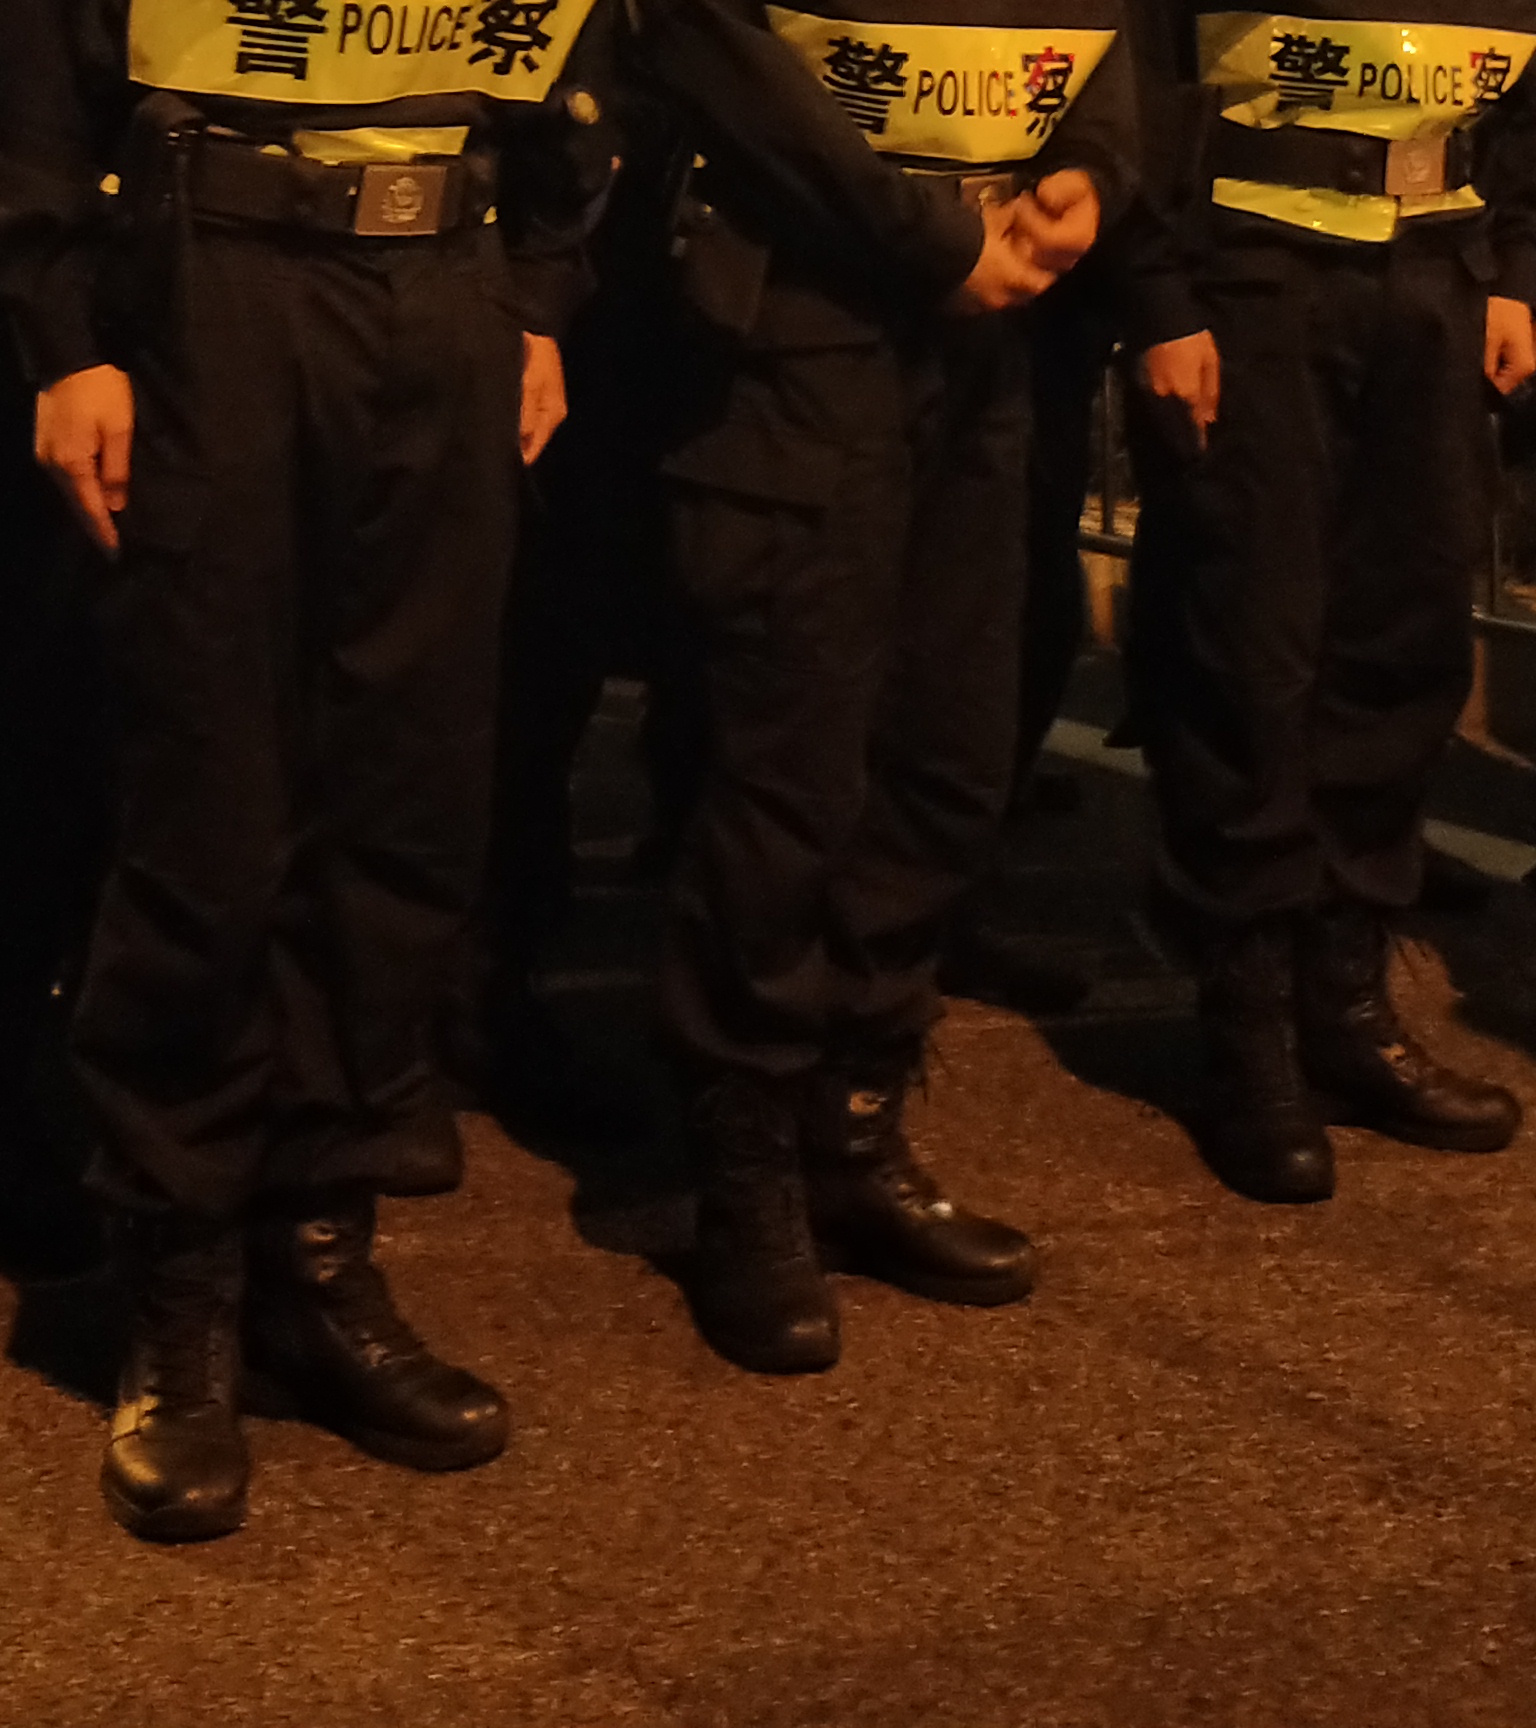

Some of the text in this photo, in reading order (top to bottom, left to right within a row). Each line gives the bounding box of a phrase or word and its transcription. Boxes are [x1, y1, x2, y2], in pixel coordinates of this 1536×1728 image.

[339, 3, 472, 55] POLICE
[822, 36, 908, 134] 警
[913, 69, 1016, 118] POLICE
[1269, 33, 1350, 112] 警
[1358, 62, 1464, 106] POLICE
